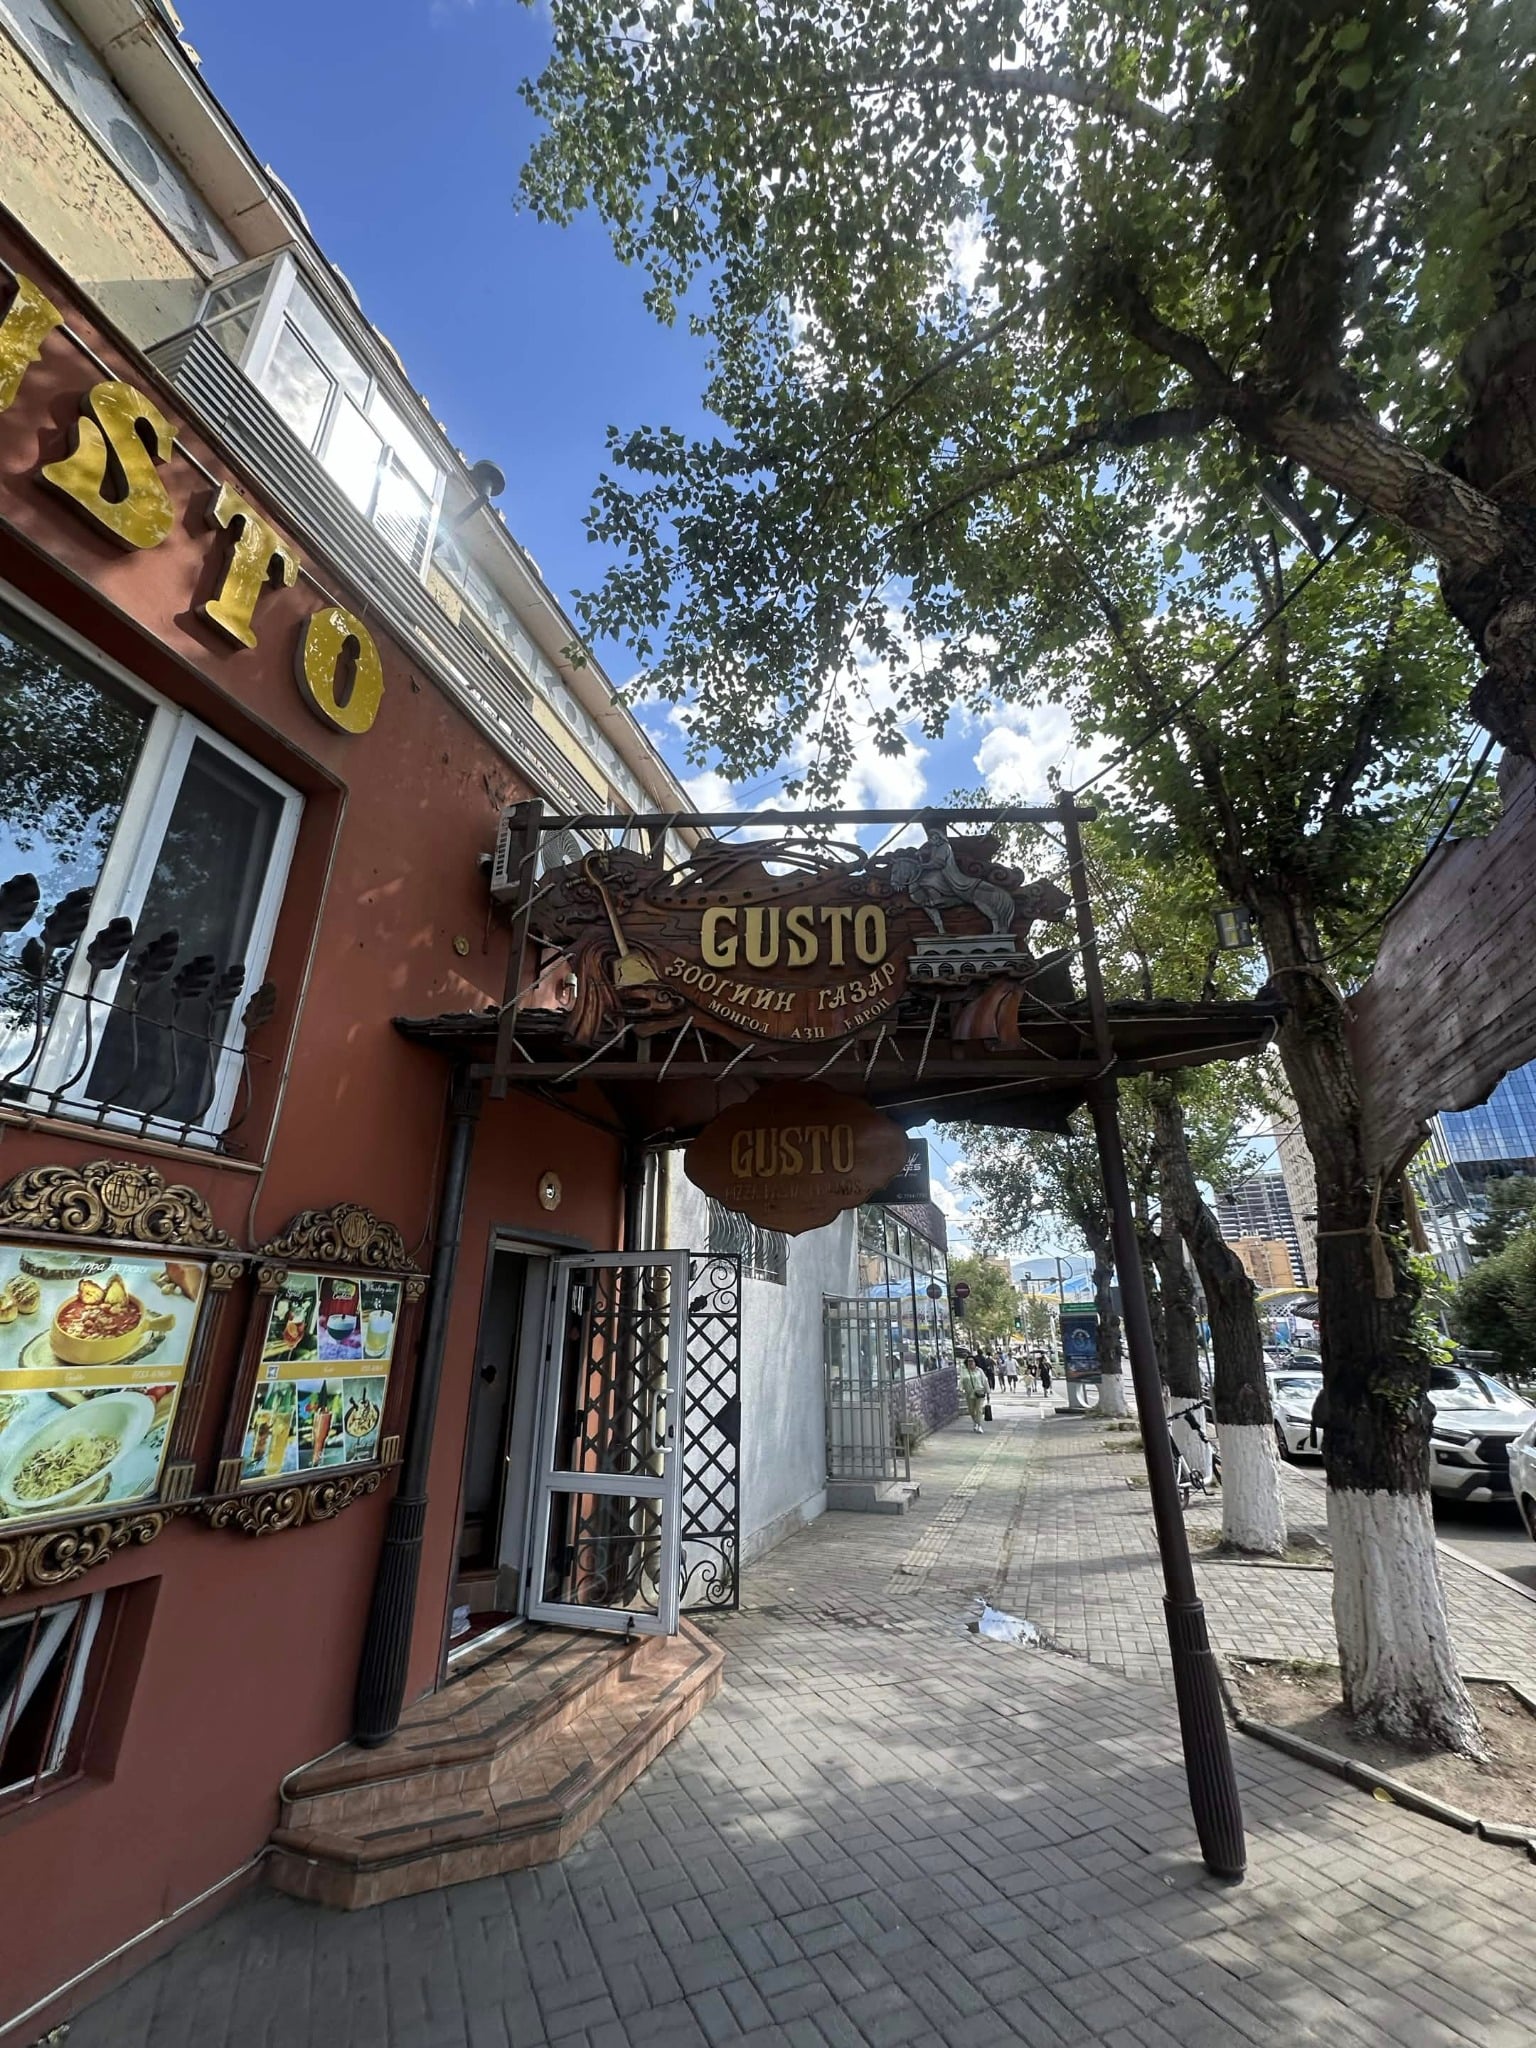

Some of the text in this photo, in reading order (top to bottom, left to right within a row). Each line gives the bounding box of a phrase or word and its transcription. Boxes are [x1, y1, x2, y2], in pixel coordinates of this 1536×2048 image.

[701, 905, 887, 968] GUSTO
[665, 957, 896, 1013] ЗООГИЙН ГАЗАР
[708, 1000, 770, 1034] МОНГОЛ
[730, 1123, 855, 1179] GUSTO
